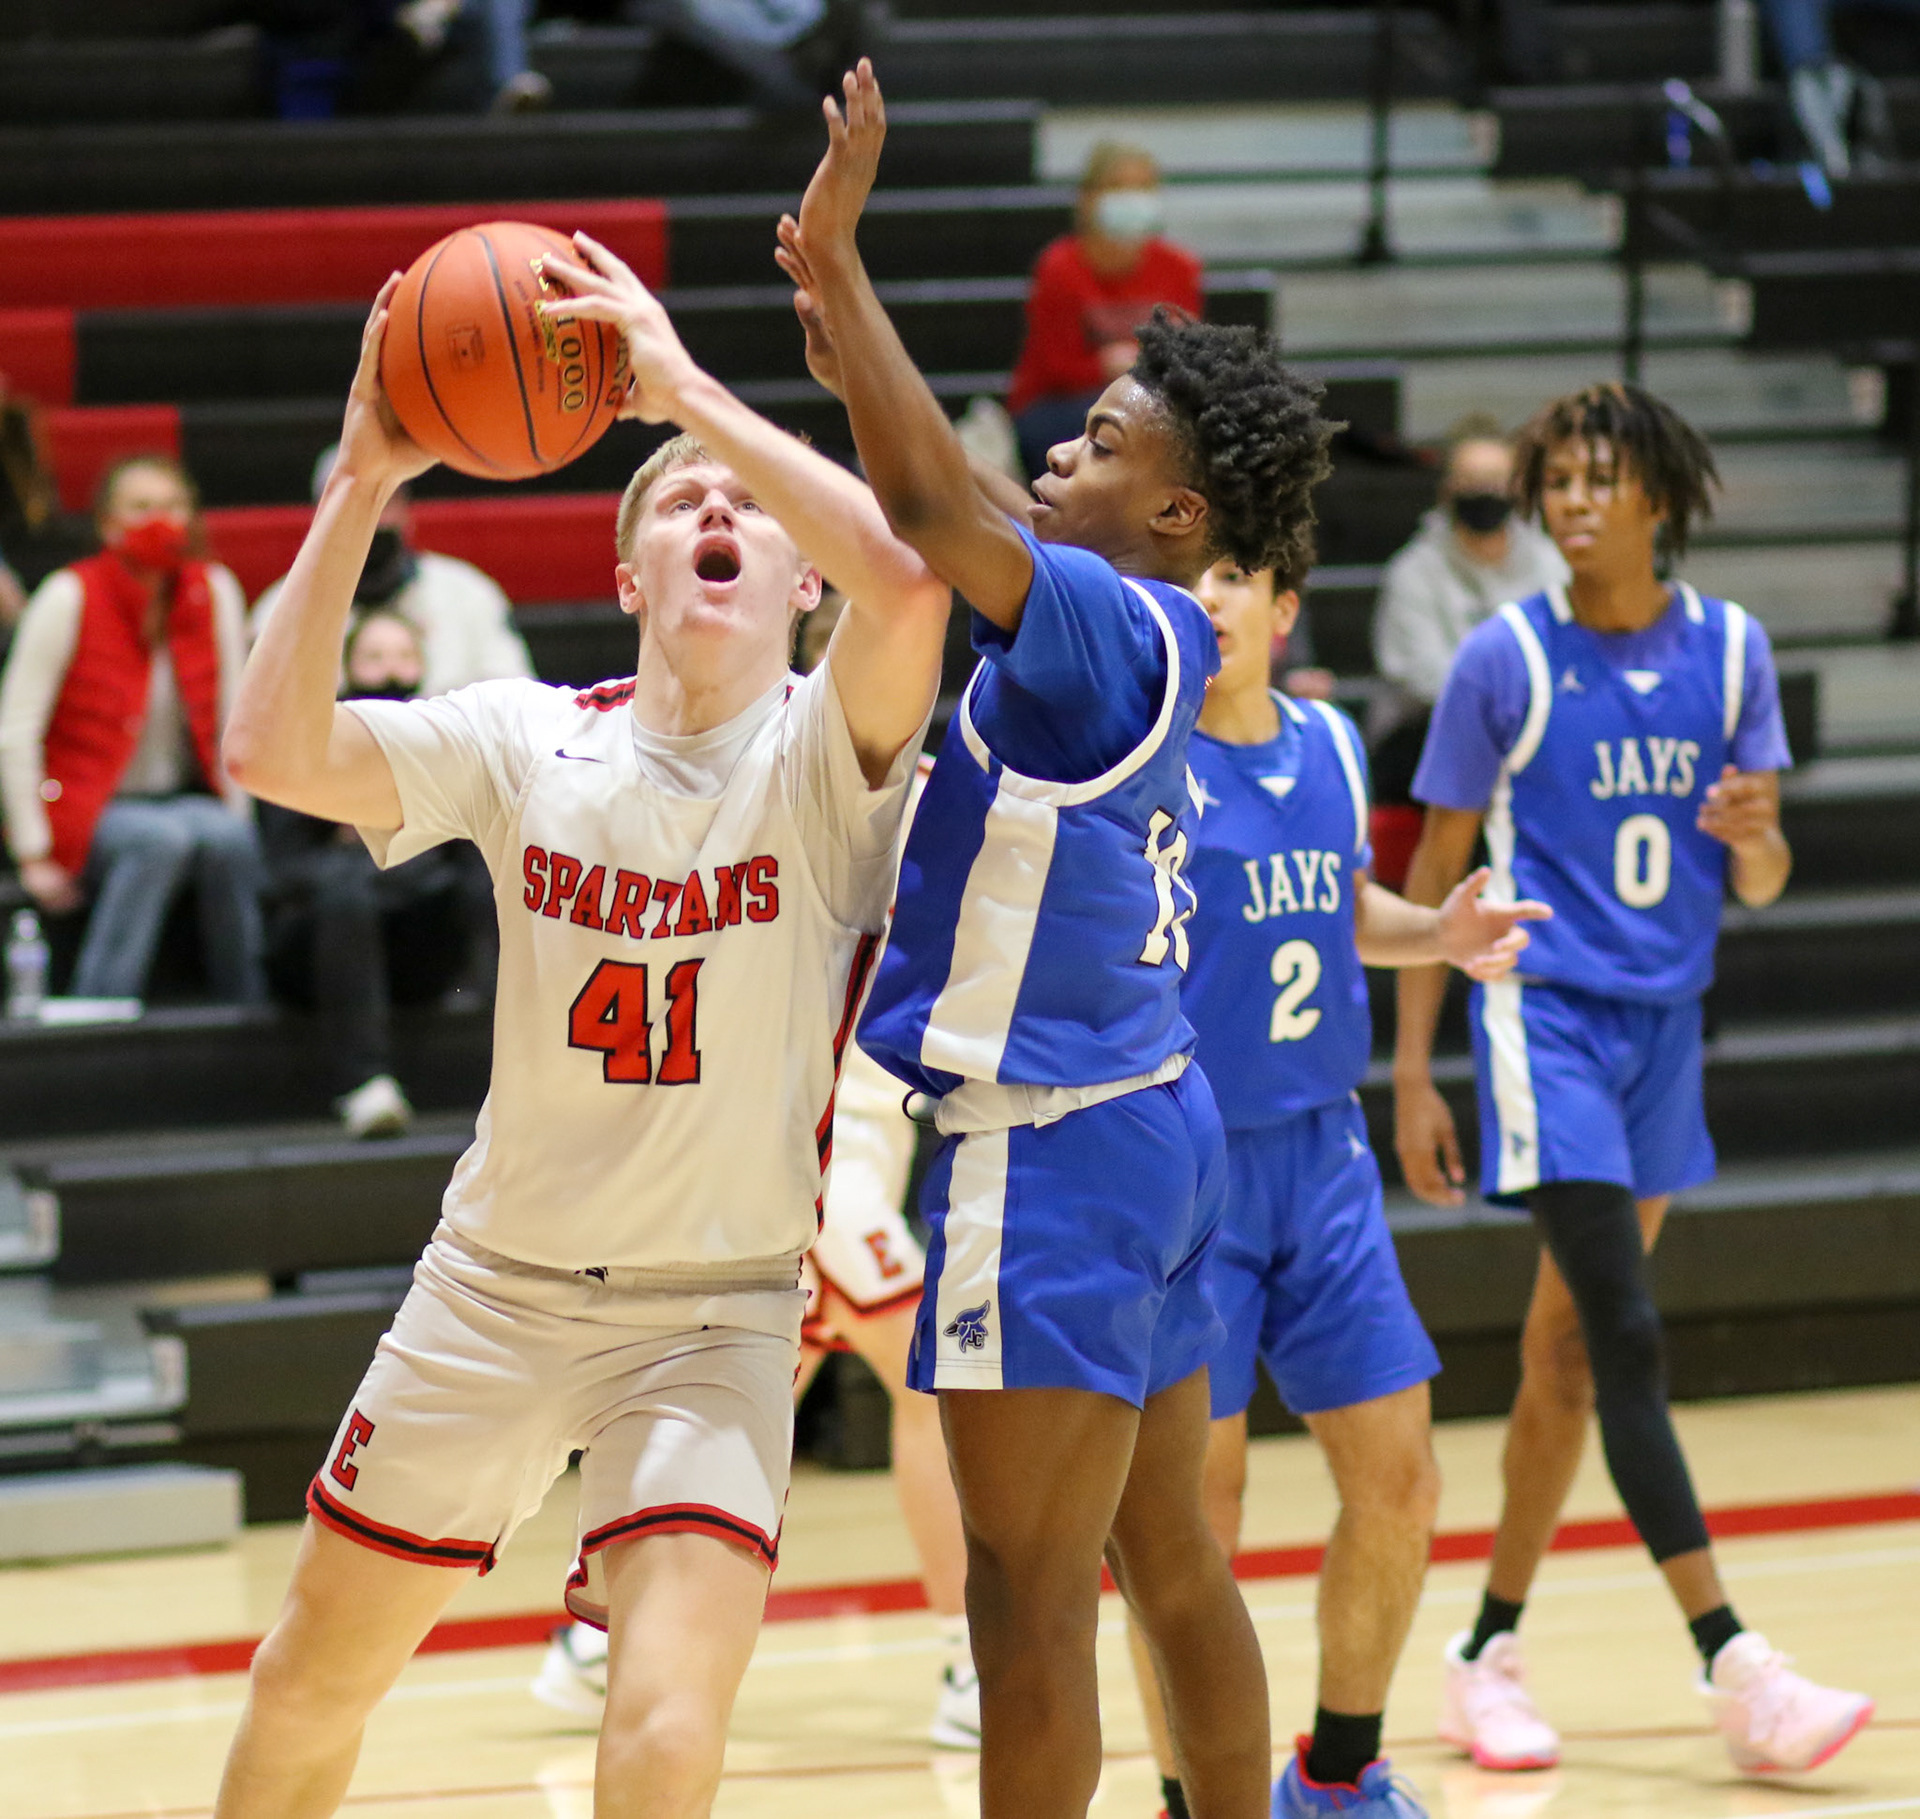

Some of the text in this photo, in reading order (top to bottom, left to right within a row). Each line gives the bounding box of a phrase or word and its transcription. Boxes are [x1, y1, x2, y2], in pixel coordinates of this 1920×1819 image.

[1590, 734, 1701, 800] JAYS
[523, 844, 780, 940] SPARTANS
[1242, 849, 1342, 924] JAYS
[1614, 812, 1673, 910] 0
[567, 957, 706, 1086] 41
[1269, 938, 1322, 1044] 2
[864, 1229, 905, 1279] E
[330, 1407, 376, 1492] E
